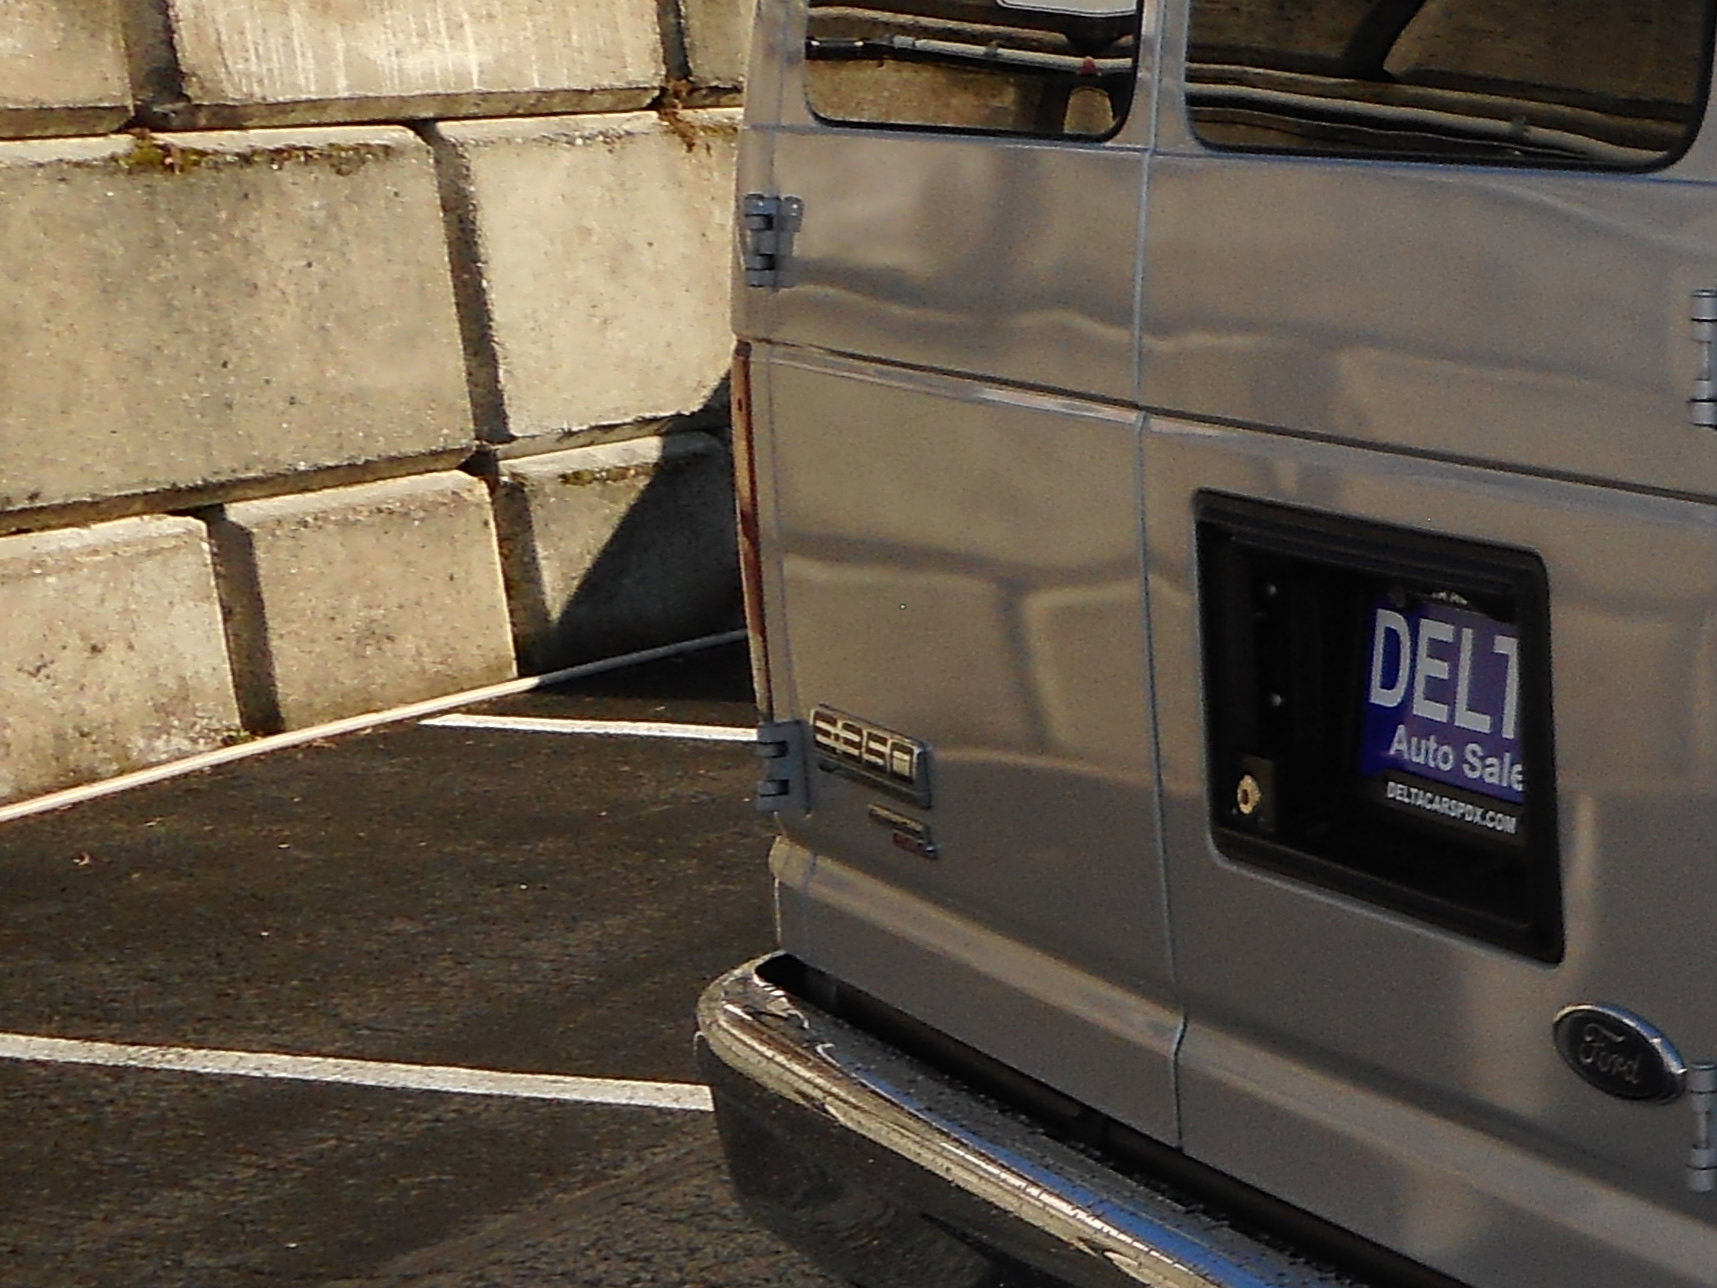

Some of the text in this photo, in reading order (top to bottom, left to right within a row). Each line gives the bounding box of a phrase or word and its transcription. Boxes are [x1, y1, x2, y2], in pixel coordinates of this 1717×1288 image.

[1369, 607, 1520, 739] DELT
[1388, 724, 1524, 792] Auto Sale
[1386, 781, 1517, 835] DELTACARSPDX.COM
[1578, 1022, 1643, 1085] Ford
